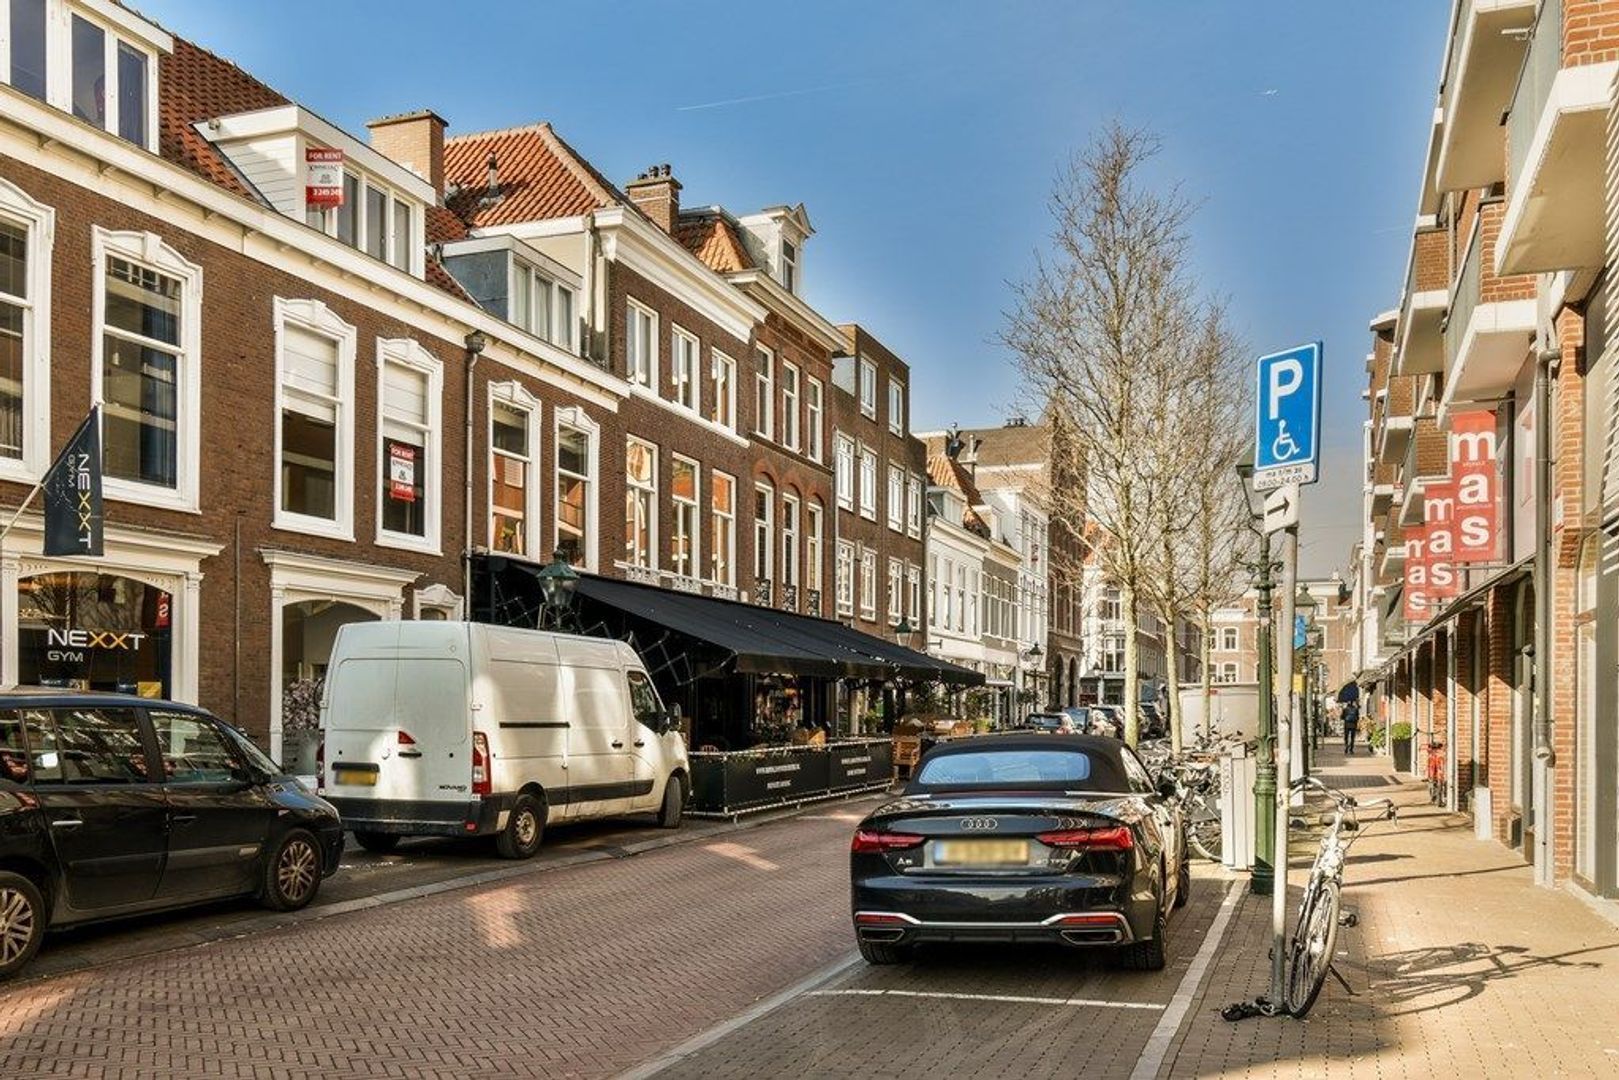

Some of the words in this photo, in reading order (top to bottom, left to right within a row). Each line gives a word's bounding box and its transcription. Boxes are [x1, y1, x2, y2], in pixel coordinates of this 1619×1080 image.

[309, 152, 323, 160] FOR
[324, 152, 342, 160] RENT
[1269, 359, 1303, 421] P
[67, 454, 76, 487] GYM
[77, 453, 92, 549] NEXXT
[48, 628, 146, 651] NEXXT
[47, 650, 84, 663] GYM
